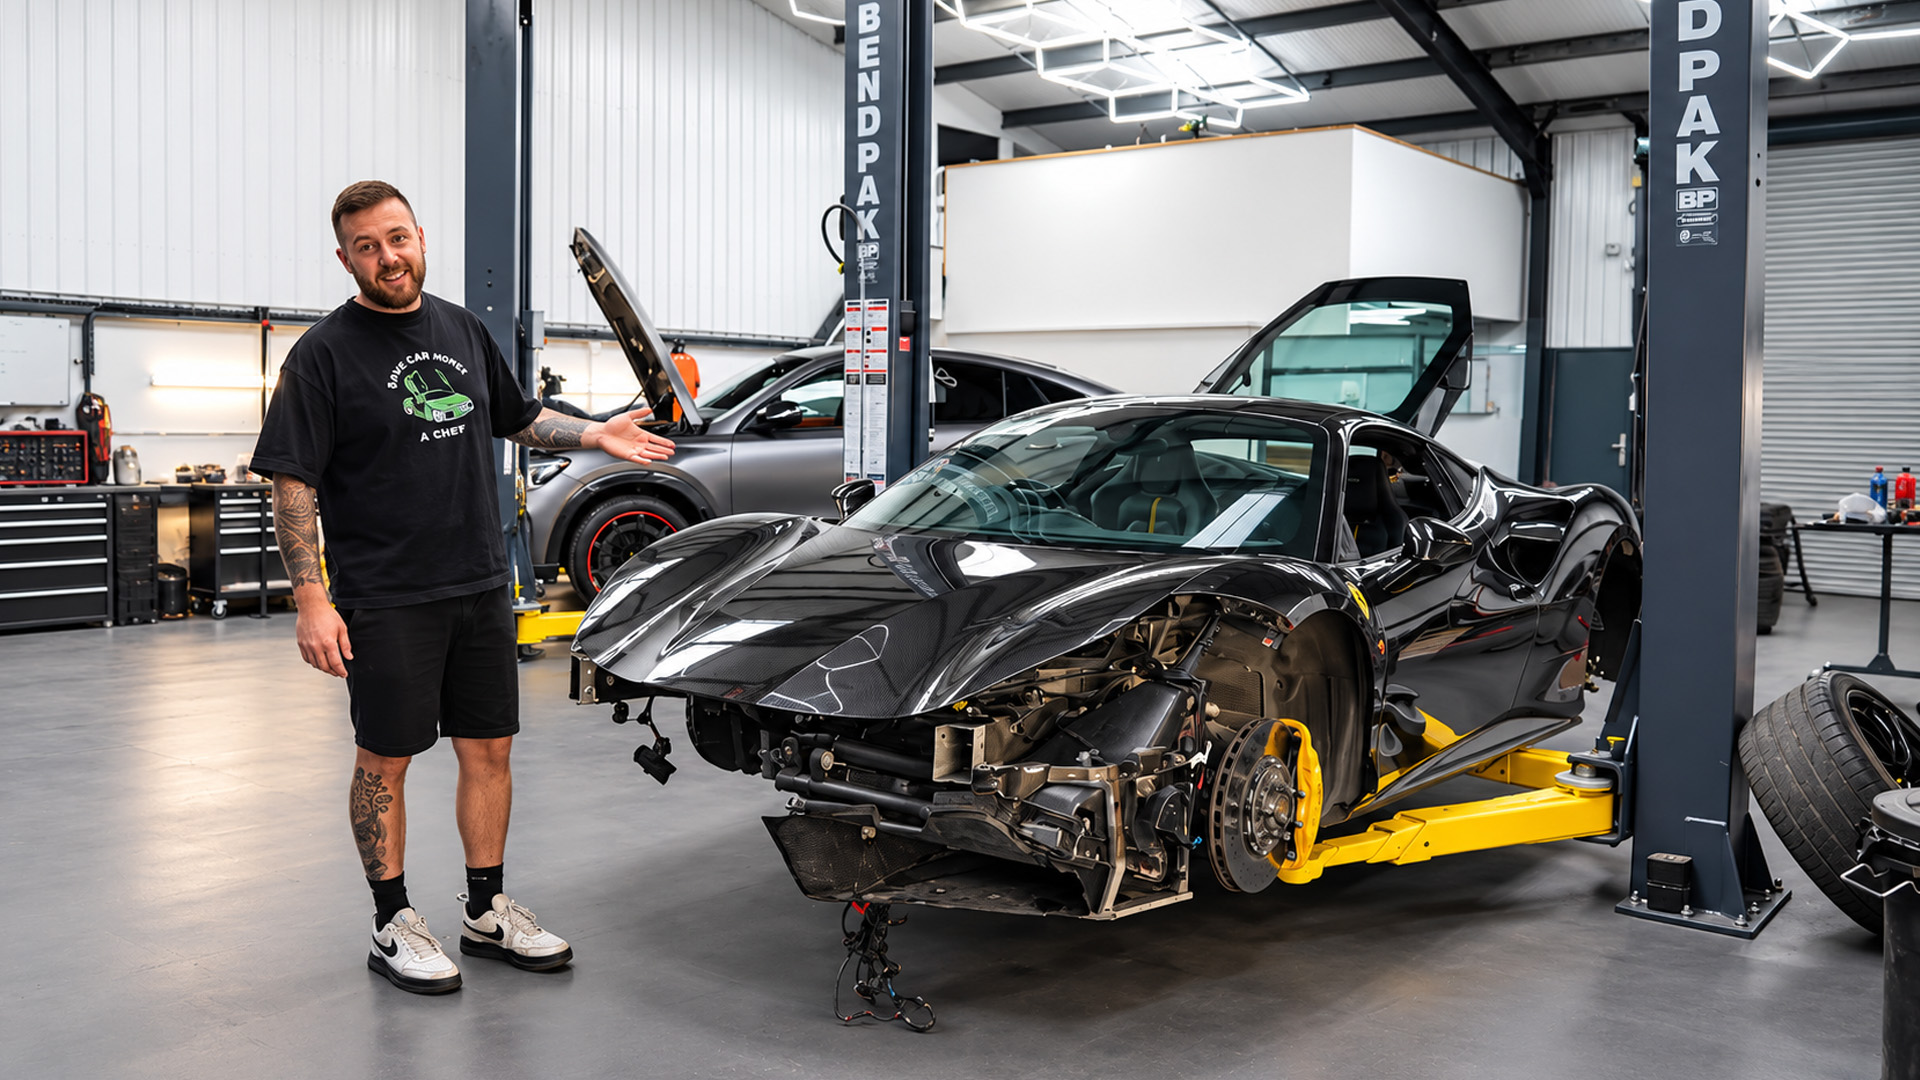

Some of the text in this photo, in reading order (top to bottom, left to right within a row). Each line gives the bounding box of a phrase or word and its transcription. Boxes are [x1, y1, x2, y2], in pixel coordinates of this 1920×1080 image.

[857, 2, 881, 240] BENDPAK
[1679, 190, 1716, 208] BP
[858, 244, 878, 259] BP
[406, 351, 430, 364] CAR
[420, 424, 465, 442] A CHEF
